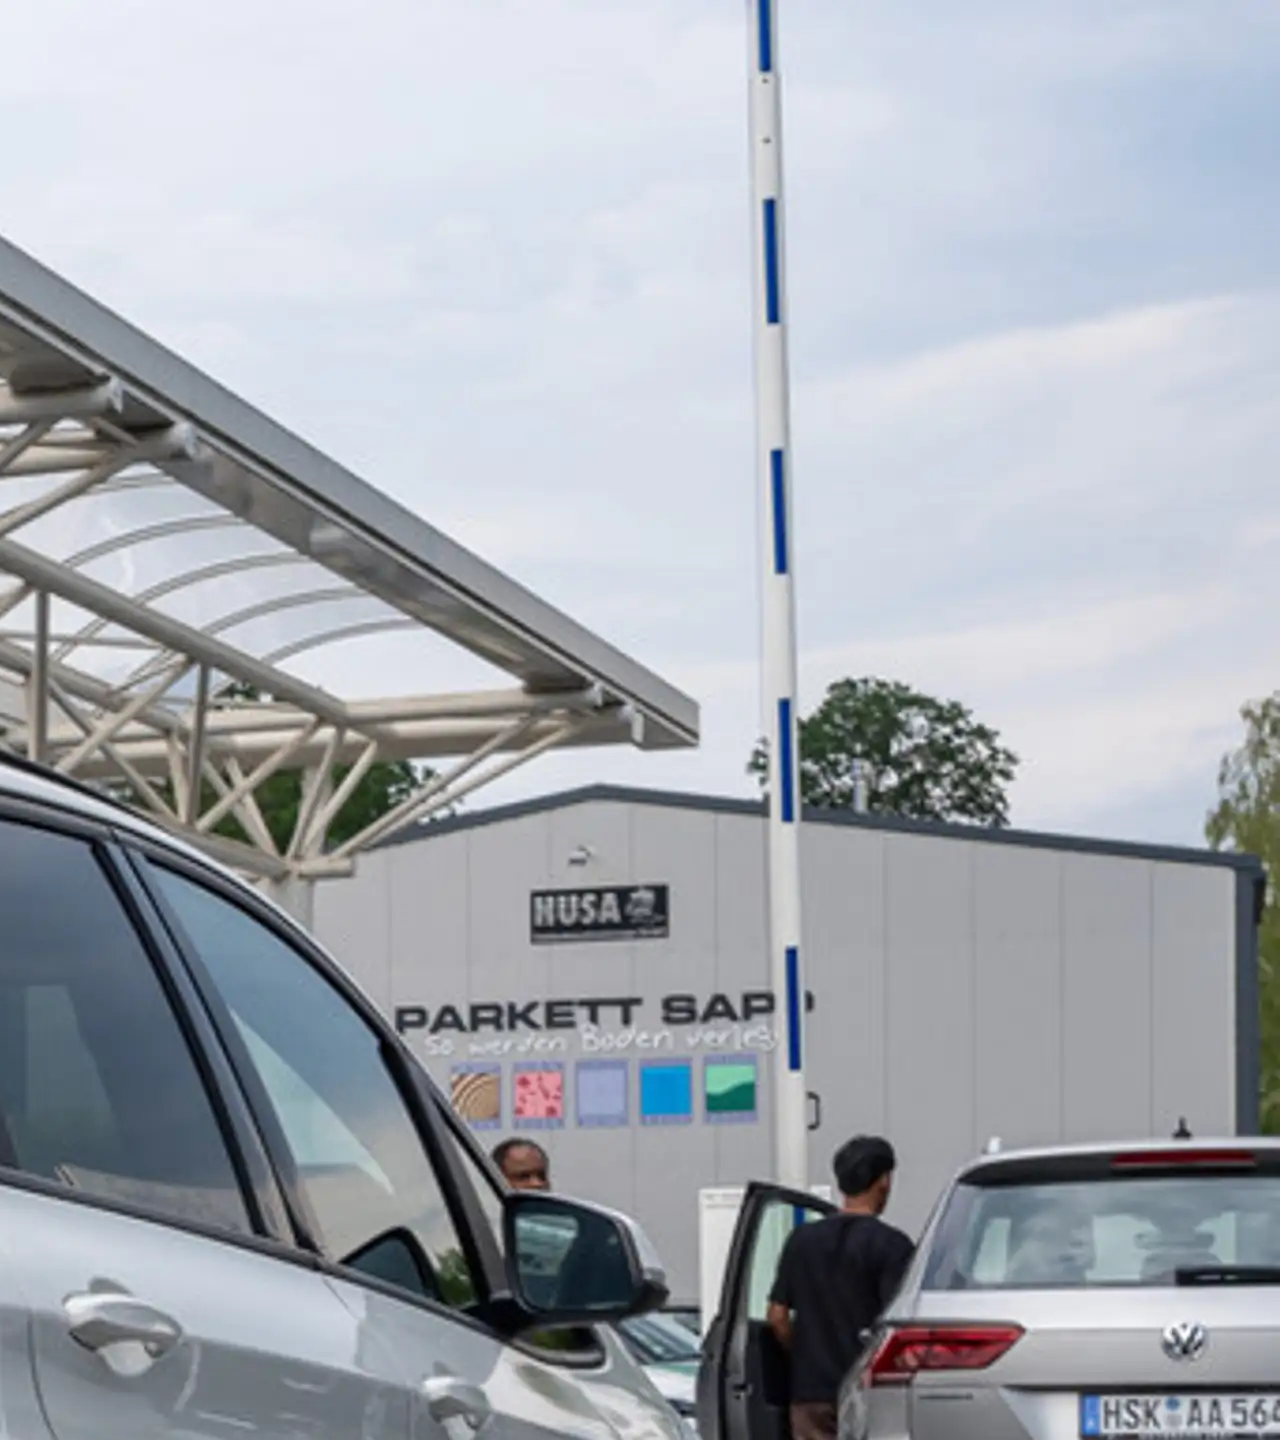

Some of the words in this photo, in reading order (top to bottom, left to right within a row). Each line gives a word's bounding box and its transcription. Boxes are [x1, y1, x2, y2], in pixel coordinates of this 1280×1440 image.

[394, 997, 643, 1034] PARKETT
[662, 990, 815, 1026] SAP
[1103, 1399, 1161, 1430] HSK
[1187, 1399, 1225, 1429] AA
